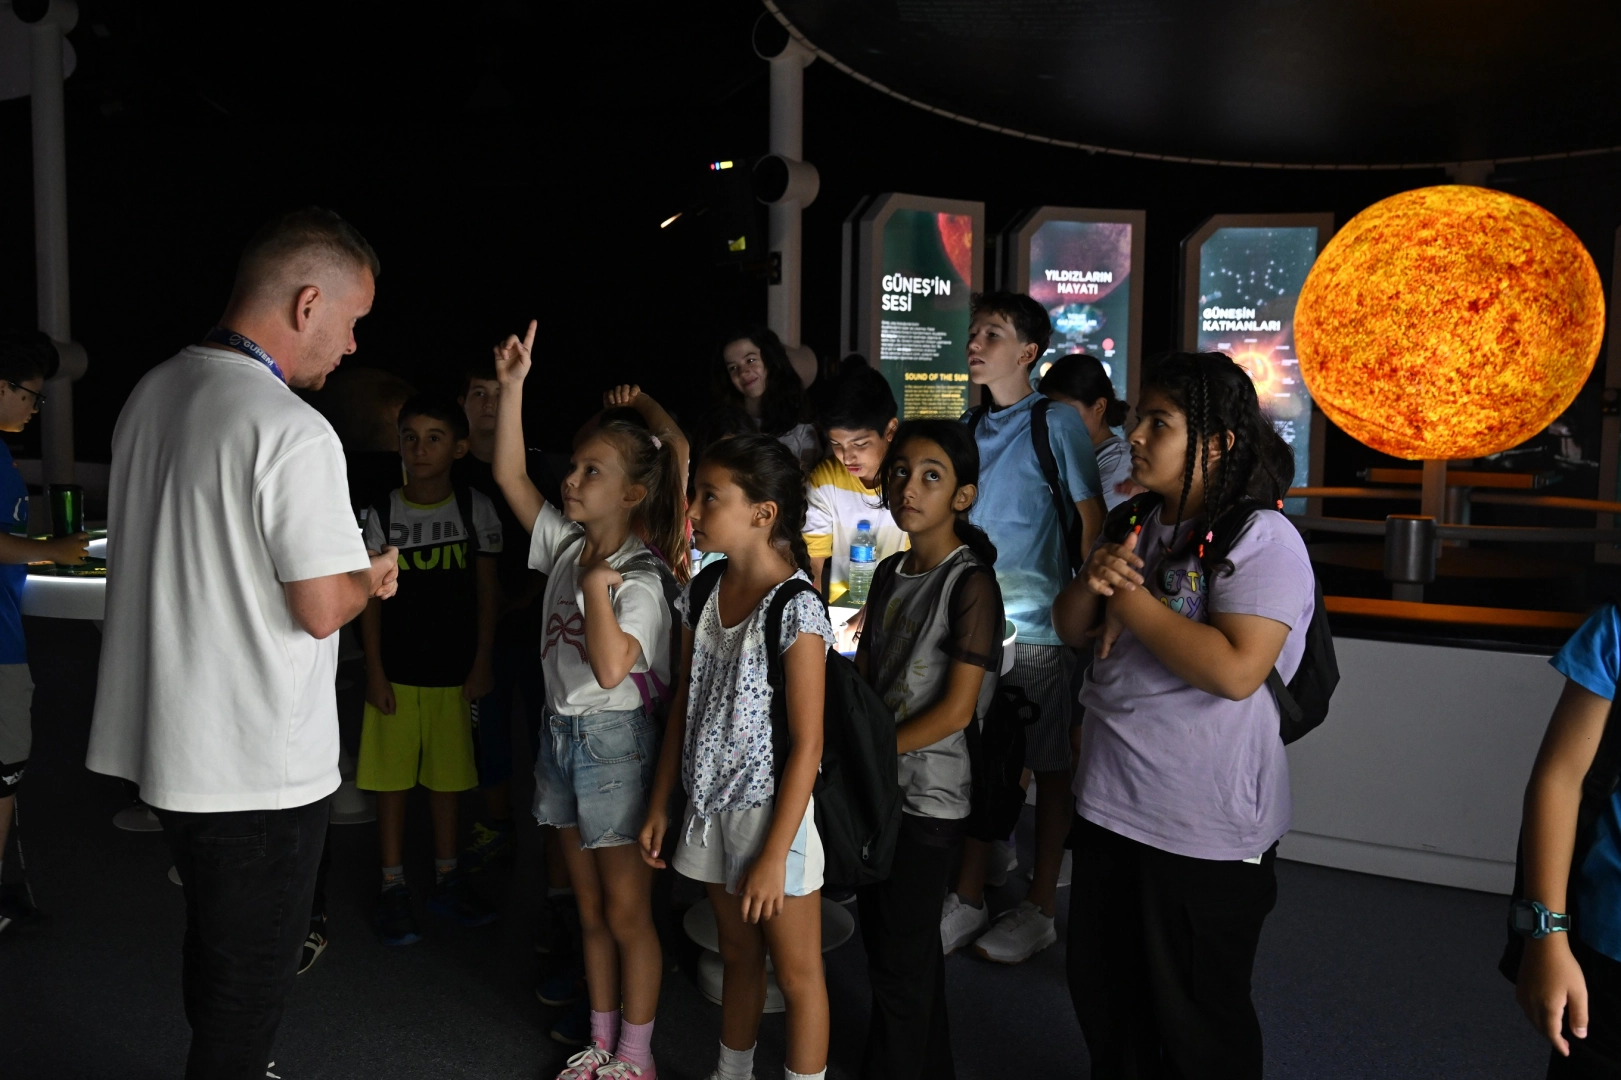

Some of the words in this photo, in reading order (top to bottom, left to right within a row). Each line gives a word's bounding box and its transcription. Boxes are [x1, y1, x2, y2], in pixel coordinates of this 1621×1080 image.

[1045, 269, 1113, 283] YILDIZLARIN
[882, 272, 951, 297] GÜNEŞ'İN
[1057, 282, 1098, 294] HAYATI
[881, 293, 912, 312] SESİ
[1202, 306, 1256, 321] GÜNEŞİN
[1202, 320, 1281, 332] KATMANLARI
[243, 340, 274, 366] GUHEM
[904, 372, 928, 381] SOUND
[929, 372, 939, 381] OF
[940, 373, 953, 381] THE
[953, 373, 969, 382] SUN
